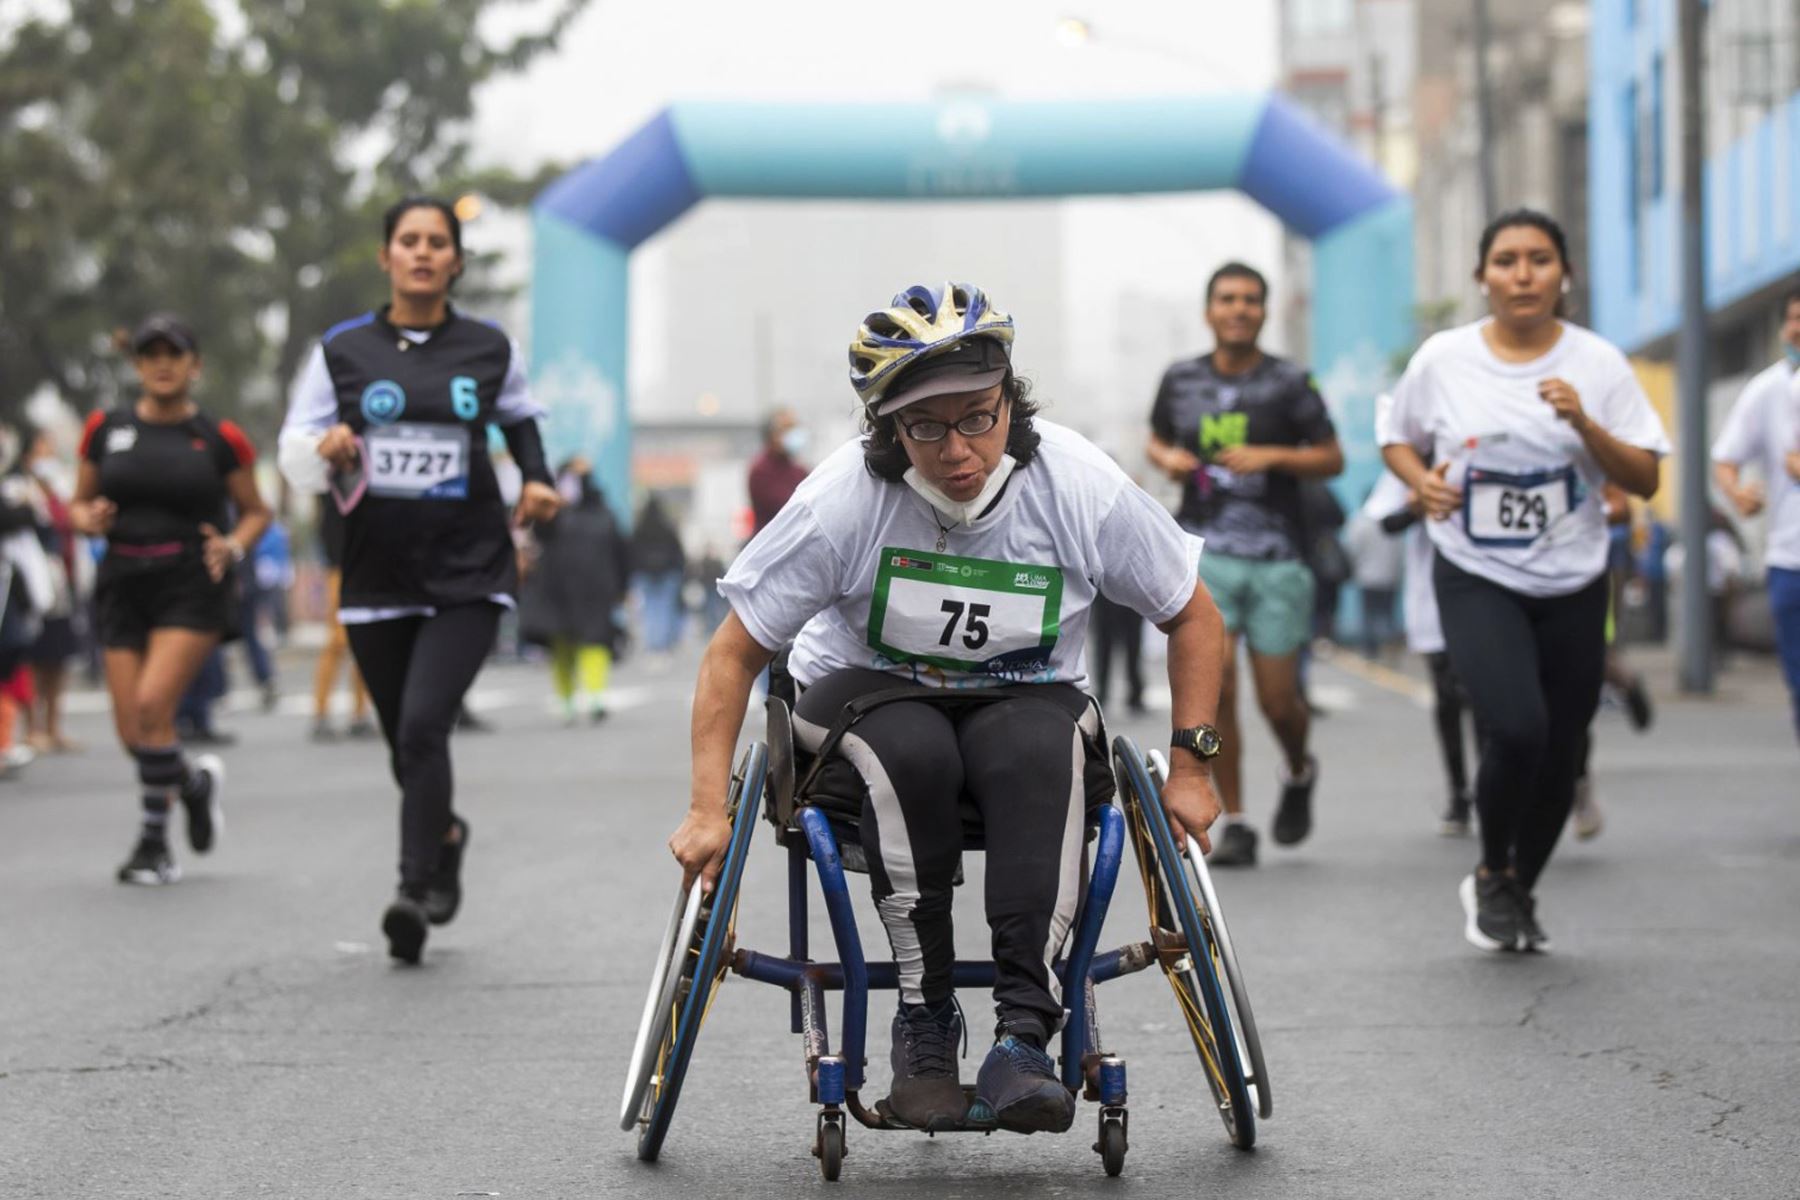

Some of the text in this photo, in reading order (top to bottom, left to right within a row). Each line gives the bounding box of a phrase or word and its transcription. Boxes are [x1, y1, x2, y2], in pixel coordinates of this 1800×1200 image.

[450, 375, 479, 420] 6
[377, 451, 452, 475] 3727
[1499, 490, 1548, 531] 629
[939, 599, 991, 650] 75
